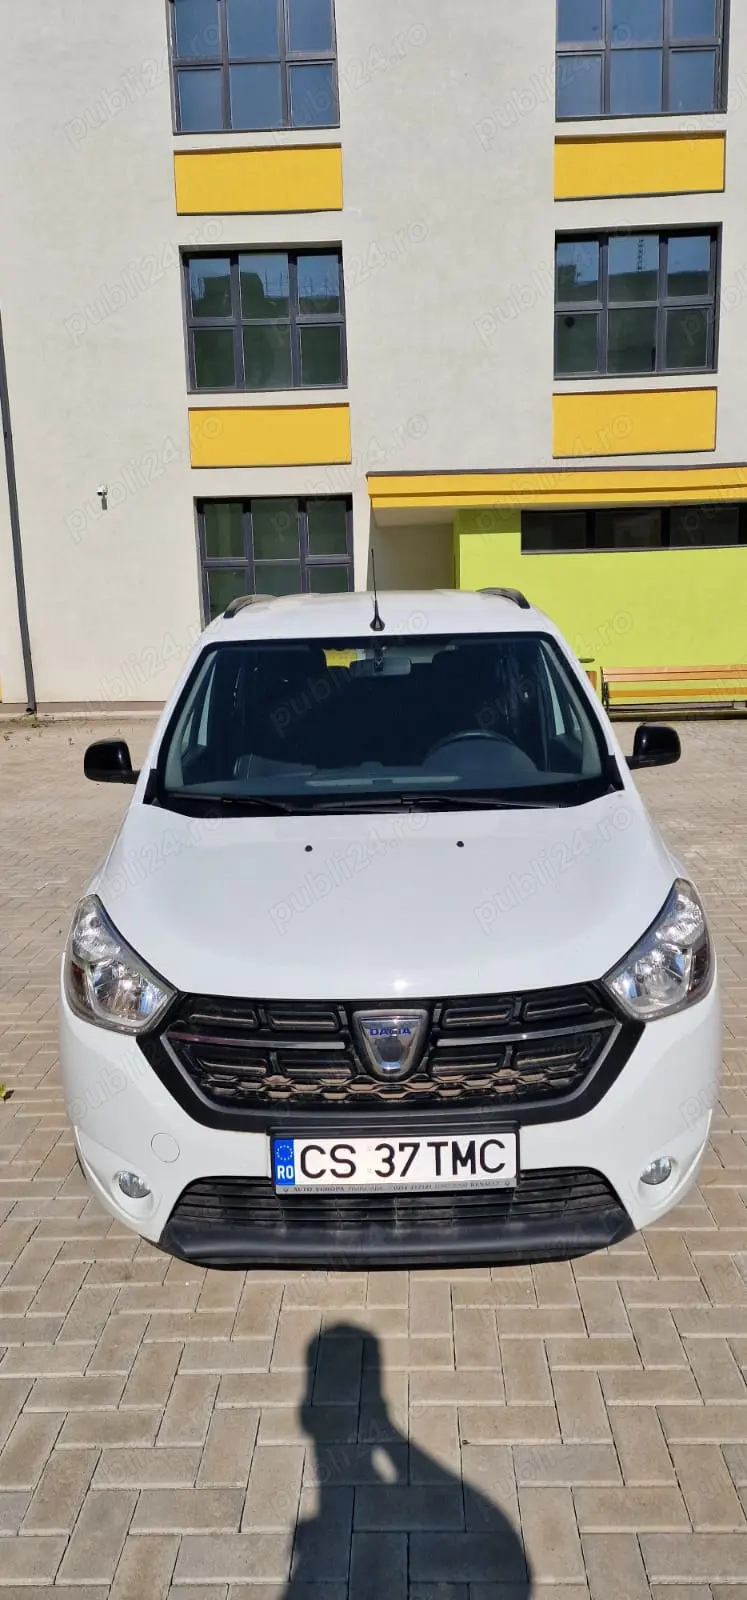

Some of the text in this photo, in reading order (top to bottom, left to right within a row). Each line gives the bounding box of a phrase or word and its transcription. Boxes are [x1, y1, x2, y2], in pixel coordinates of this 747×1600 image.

[370, 1026, 411, 1036] DACIA
[300, 1138, 506, 1179] CS 37 TMC
[277, 1165, 294, 1180] RO
